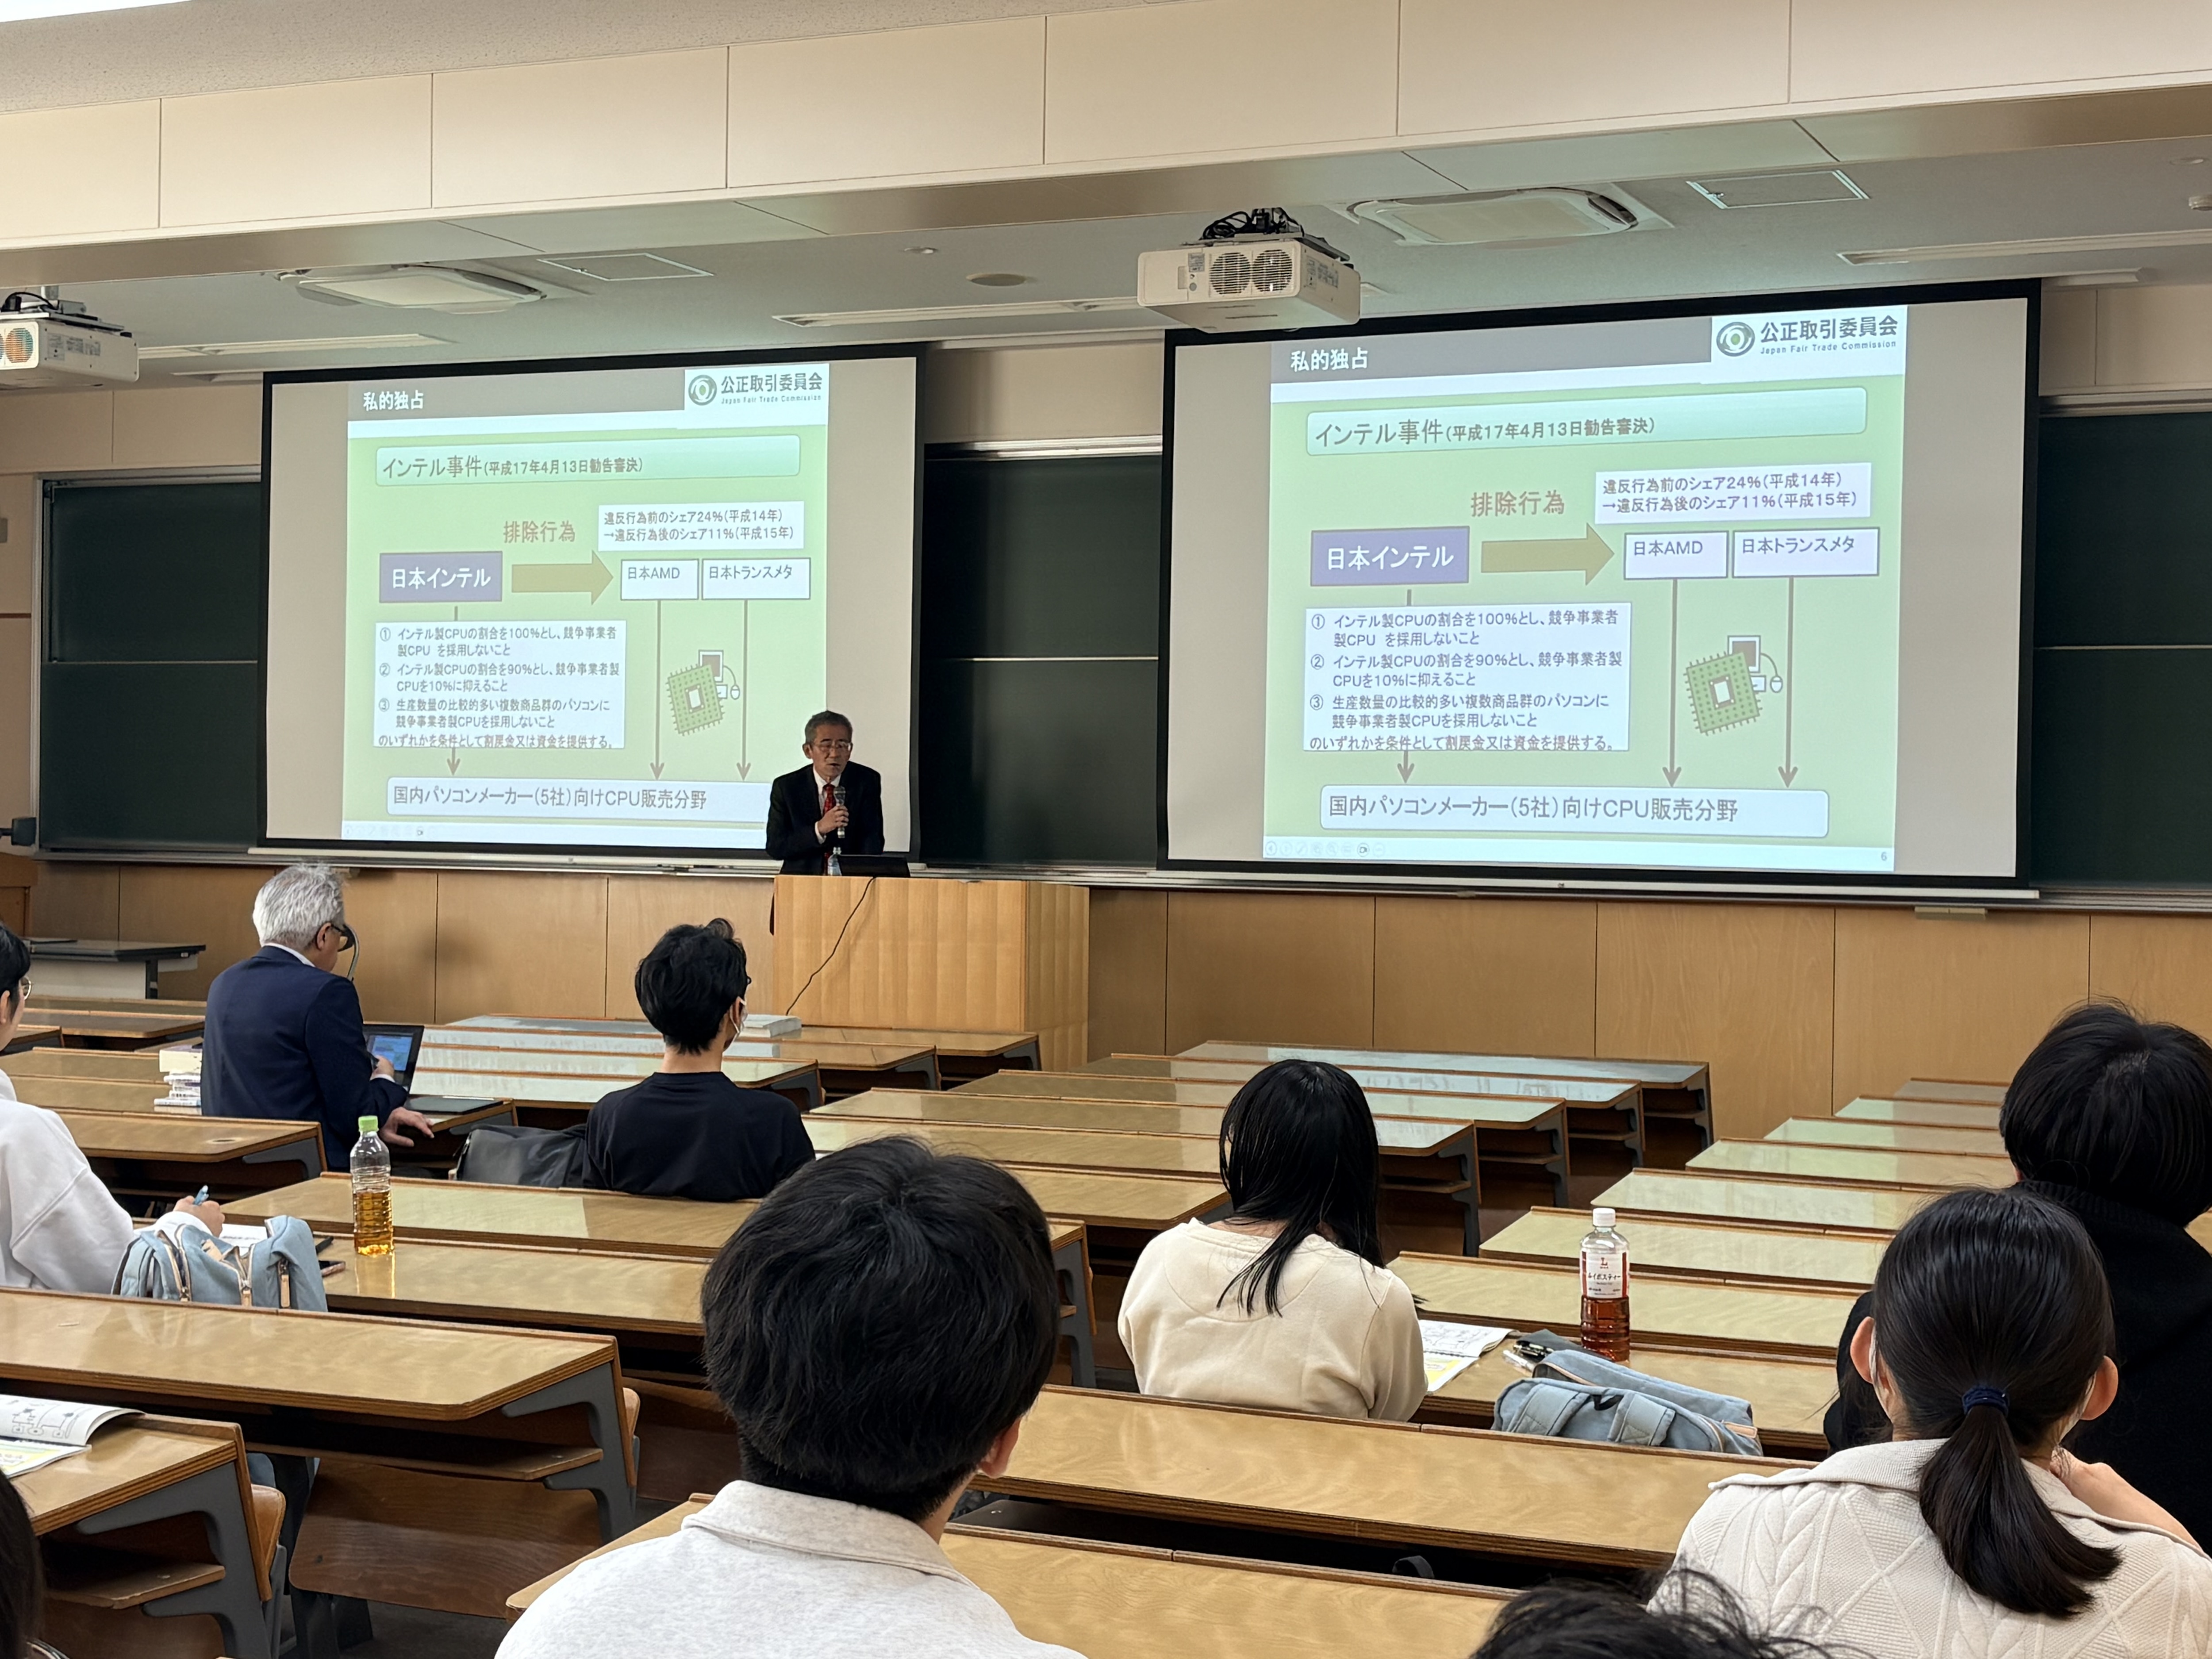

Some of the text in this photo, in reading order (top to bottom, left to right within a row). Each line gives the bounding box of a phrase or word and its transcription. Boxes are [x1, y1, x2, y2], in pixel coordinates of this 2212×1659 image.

[1760, 315, 1898, 342] 公正取引委員会
[1842, 341, 1896, 350] Commission
[1290, 347, 1368, 372] 私的独占
[721, 372, 822, 394] 公正取引委員会
[363, 390, 423, 411] 私的独占
[1471, 489, 1565, 517] 排除行為
[503, 520, 575, 544] 排除行為
[1634, 540, 1703, 556] 日本AMD
[1742, 536, 1855, 554] 日本トランスメタ
[1328, 545, 1454, 571] 日本インテル
[393, 567, 491, 589] 日本インテル
[628, 567, 680, 580] 日本AMD
[710, 565, 792, 580] 日本トランスメタ
[1881, 851, 1887, 861] 6
